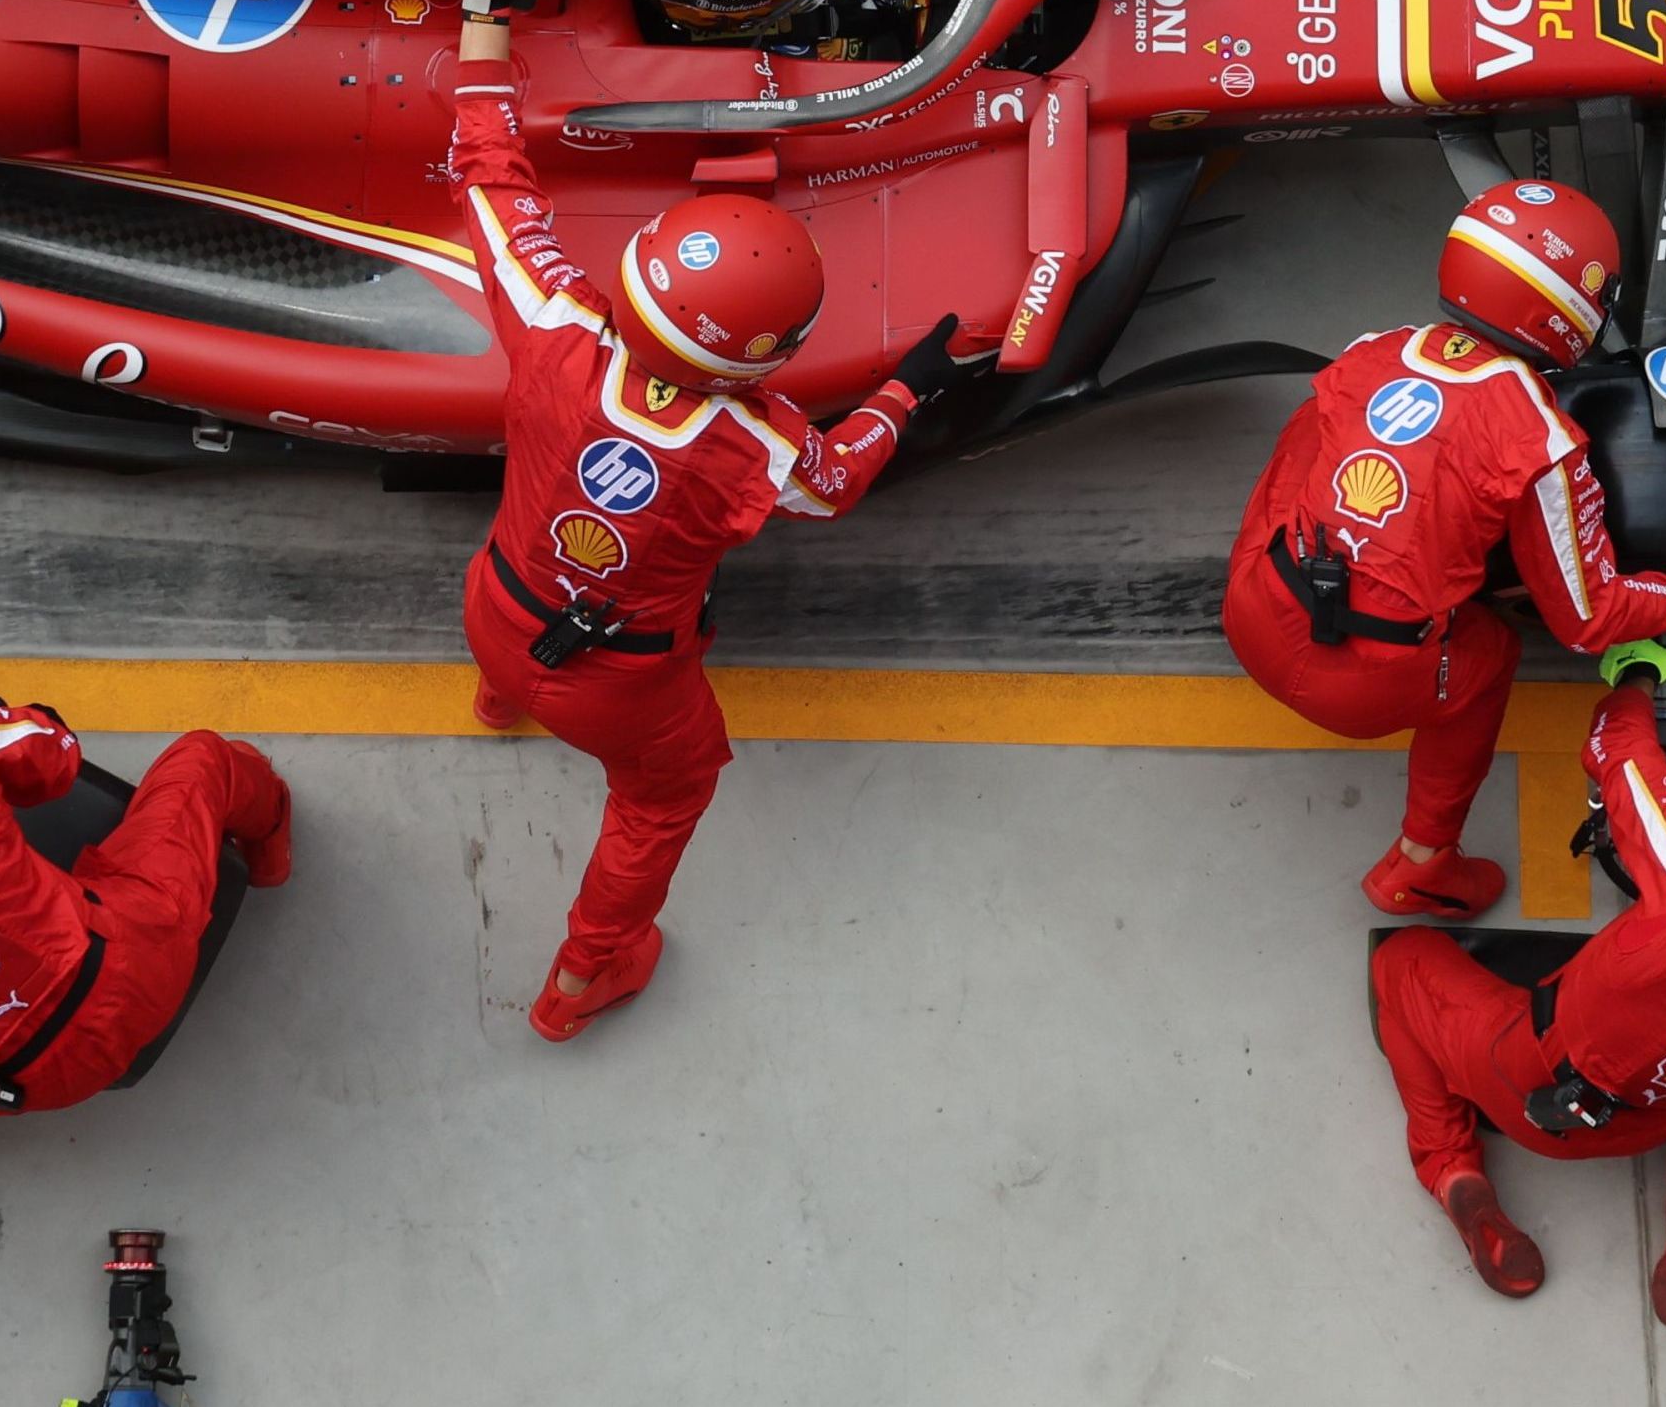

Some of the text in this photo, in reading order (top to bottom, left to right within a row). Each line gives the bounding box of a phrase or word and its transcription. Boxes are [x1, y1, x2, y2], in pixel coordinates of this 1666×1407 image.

[711, 0, 771, 12] Bitdefender
[817, 55, 924, 103] RICHARD MILLE
[899, 51, 988, 119] TECHNOLOGY
[729, 101, 784, 111] Bitdefender
[976, 91, 986, 128] CELSIUS
[808, 141, 980, 188] HARMAN AUTOMOTIVE
[1519, 185, 1552, 203] hp
[683, 234, 717, 270] hp
[1542, 228, 1574, 257] PERONI
[1010, 250, 1065, 348] VGW PLAY
[697, 314, 730, 341] PERONI
[1371, 379, 1437, 444] hp
[585, 441, 653, 511] hp
